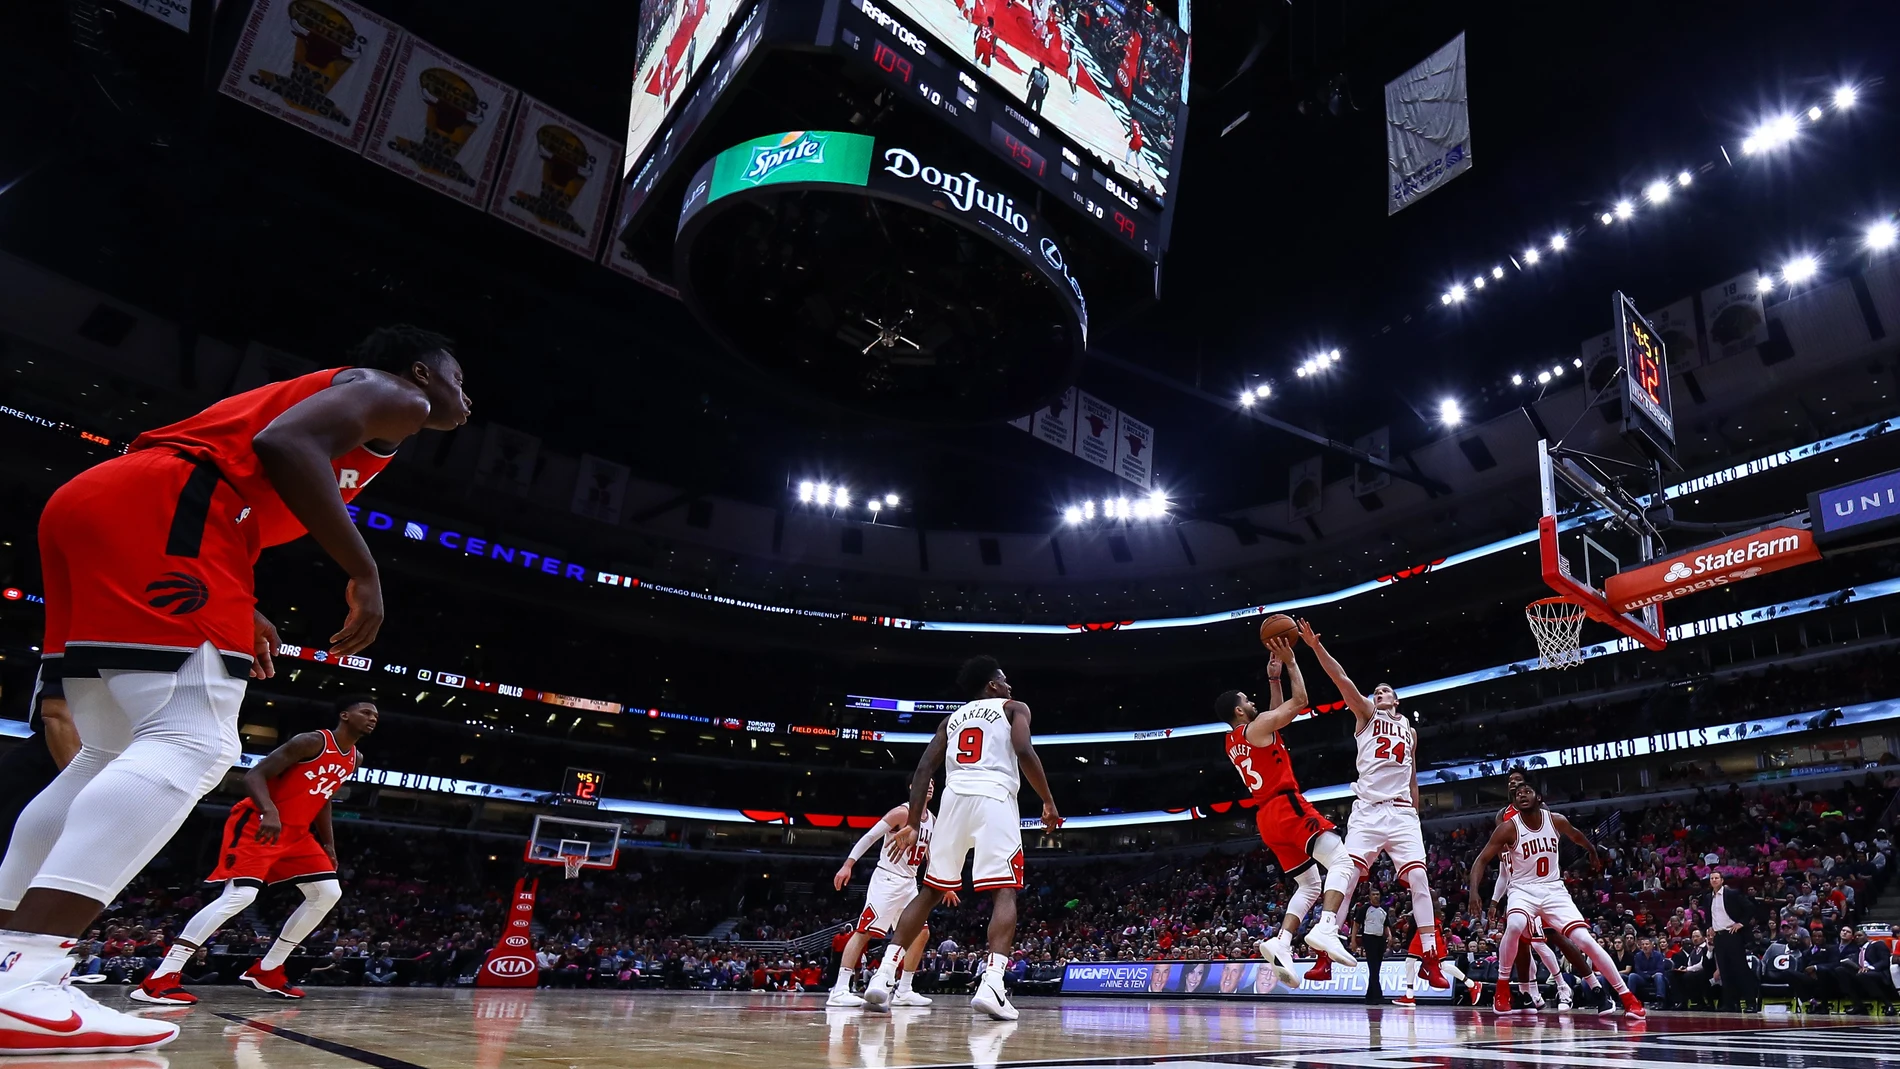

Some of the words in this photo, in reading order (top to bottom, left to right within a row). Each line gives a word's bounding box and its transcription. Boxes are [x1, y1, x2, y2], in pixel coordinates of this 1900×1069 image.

[862, 0, 927, 56] RAPTORS
[874, 44, 914, 84] 109
[1005, 104, 1030, 128] PERIOD
[748, 136, 820, 179] Sprite
[1004, 134, 1046, 178] 4:51
[1394, 157, 1443, 191] UNITED
[1105, 177, 1139, 210] BULLS
[1114, 211, 1136, 240] 99
[1639, 352, 1661, 406] 12
[1644, 398, 1672, 431] TISSOT
[1678, 465, 1737, 497] CHICAGO
[1747, 449, 1793, 475] BULLS
[1834, 488, 1895, 517] UNI
[440, 531, 586, 582] CENTER
[640, 583, 654, 592] THE
[655, 586, 689, 597] CHICAGO
[690, 591, 712, 601] BULLS
[737, 600, 762, 611] RAFFLE
[763, 604, 794, 615] JACKPOT
[795, 608, 803, 616] IS
[803, 609, 840, 619] CURRENTLY
[1694, 611, 1743, 636] BULLS
[347, 656, 366, 668] 109
[384, 662, 407, 675] 4:51
[445, 675, 458, 686] 99
[498, 684, 524, 698] BULLS
[746, 725, 775, 733] CHICAGO
[747, 720, 776, 728] TORONTO
[792, 726, 812, 734] FIELD
[812, 728, 836, 736] GOALS
[948, 707, 1002, 733] BLAKENEY
[1372, 719, 1411, 747] BULLS
[956, 726, 985, 765] 9
[1375, 736, 1405, 765] 24
[1560, 738, 1636, 767] CHICAGO
[1648, 727, 1709, 758] BULLS
[309, 776, 338, 800] 34
[401, 772, 458, 794] BULLS
[577, 772, 600, 784] 4:51
[572, 798, 597, 807] TISSOT
[576, 782, 596, 799] 12
[1521, 837, 1558, 861] BULLS
[1536, 856, 1550, 878] 0
[509, 937, 525, 945] KIA
[495, 960, 527, 973] KIA
[1105, 980, 1123, 988] NINE
[1131, 980, 1146, 988] TEN
[1381, 973, 1432, 992] NEW
